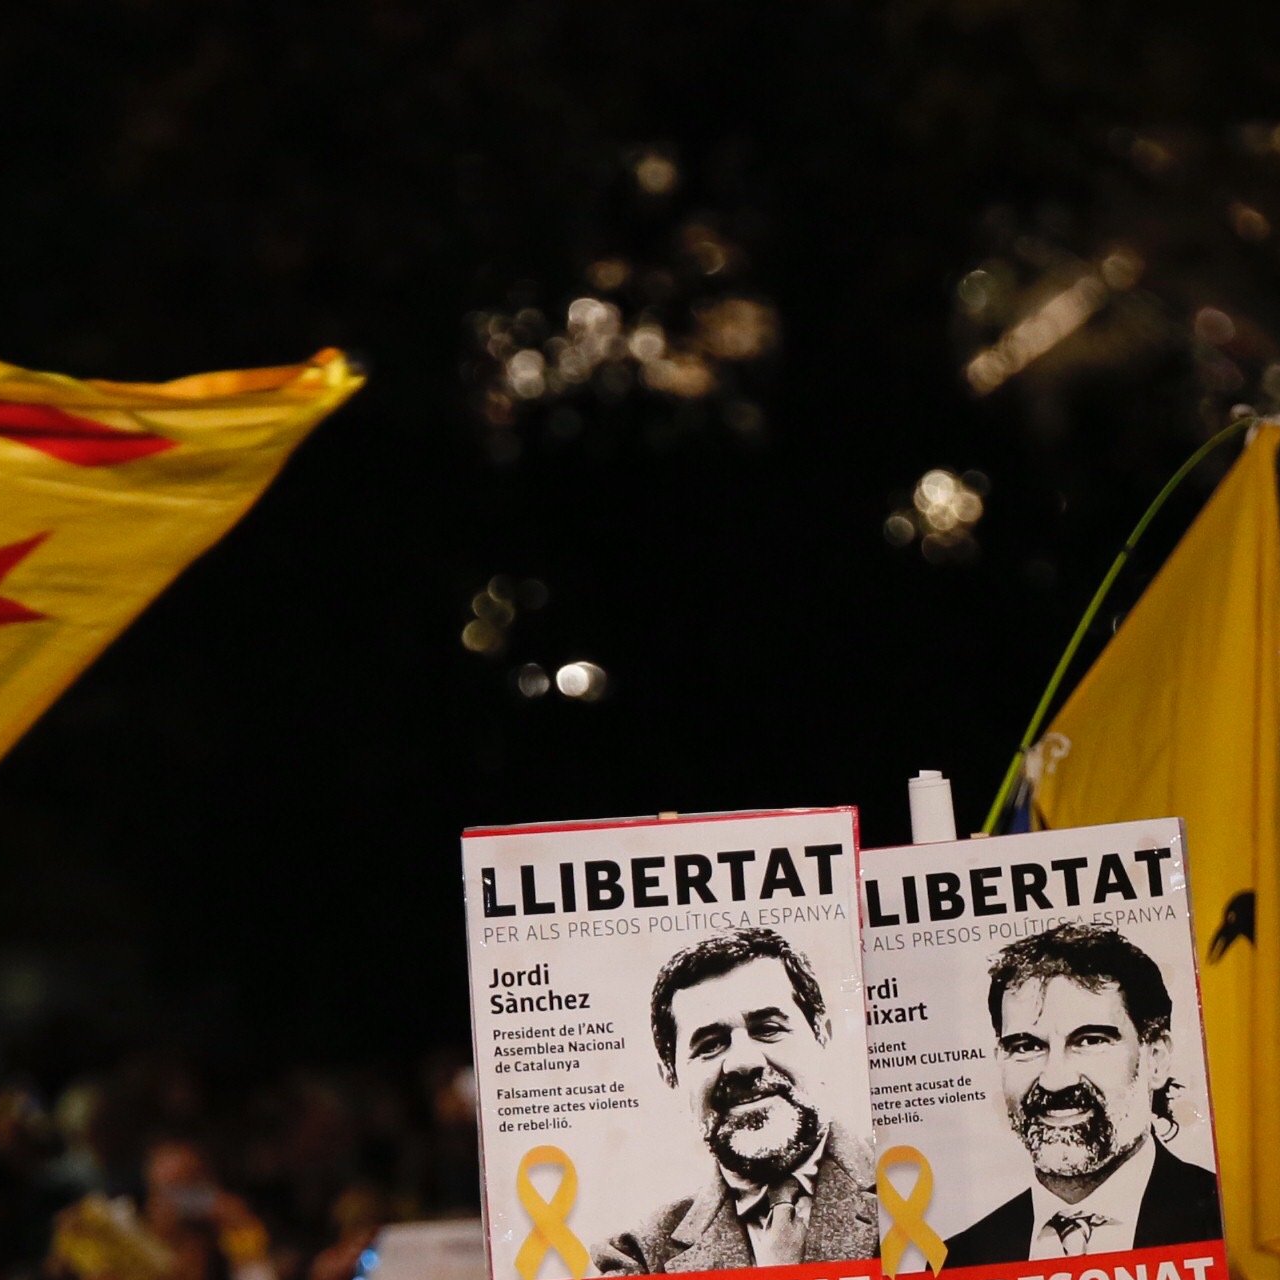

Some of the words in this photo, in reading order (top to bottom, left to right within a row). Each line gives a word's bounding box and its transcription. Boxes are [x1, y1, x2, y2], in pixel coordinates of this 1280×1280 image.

[481, 844, 842, 918] LLIBERTAT
[865, 848, 1171, 928] LIBERTAT
[484, 926, 519, 943] PER
[527, 923, 560, 940] ALS
[568, 918, 640, 938] PRESOS
[649, 911, 737, 933] POLÍTICS
[740, 911, 751, 927] A
[759, 904, 845, 925] ESPANYA
[874, 934, 905, 952] ALS
[913, 926, 981, 947] PRESOS
[1093, 905, 1176, 926] ESPANYA
[489, 963, 549, 988] Jordi
[867, 978, 898, 1000] rdi
[491, 990, 590, 1014] Sànchez
[493, 1027, 555, 1040] President
[559, 1025, 574, 1036] de
[494, 1043, 564, 1057] Assemblea
[568, 1037, 624, 1052] Nacional
[868, 1041, 906, 1054] sident
[495, 1062, 510, 1073] de
[514, 1059, 579, 1072] Catalunya
[870, 1055, 916, 1069] MNIUM
[920, 1049, 985, 1064] CULTURAL
[497, 1087, 562, 1099] Falsament
[566, 1084, 606, 1095] acusat
[610, 1081, 624, 1092] de
[870, 1083, 912, 1095] sament
[916, 1079, 954, 1091] acusat
[957, 1076, 971, 1086] de
[498, 1104, 549, 1116] cometre
[553, 1102, 585, 1112] actes
[589, 1098, 639, 1110] violents
[905, 1097, 935, 1107] actes
[938, 1091, 985, 1104] violents
[499, 1121, 514, 1132] de
